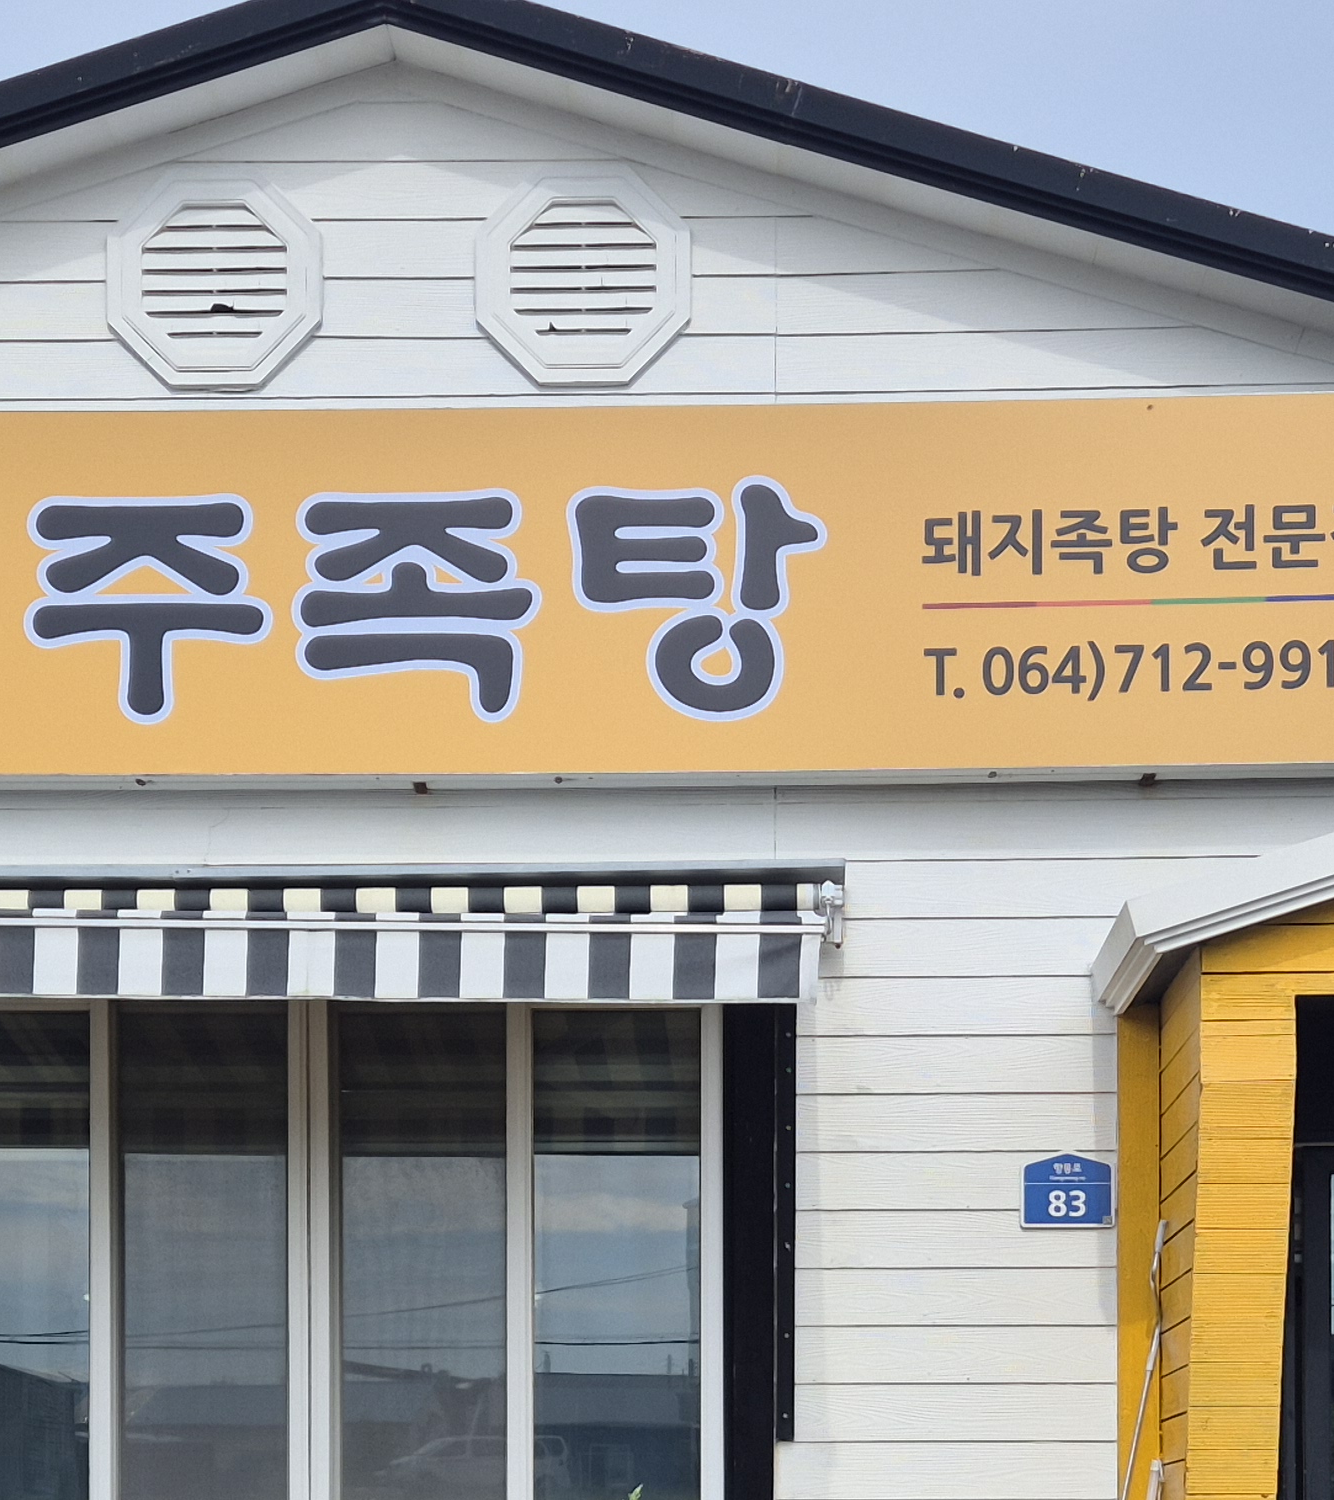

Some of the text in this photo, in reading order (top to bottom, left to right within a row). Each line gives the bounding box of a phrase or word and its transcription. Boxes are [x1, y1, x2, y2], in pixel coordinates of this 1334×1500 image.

[920, 505, 1179, 578] 돼지족탕
[922, 646, 966, 700] T.
[1047, 1189, 1086, 1217] 83
